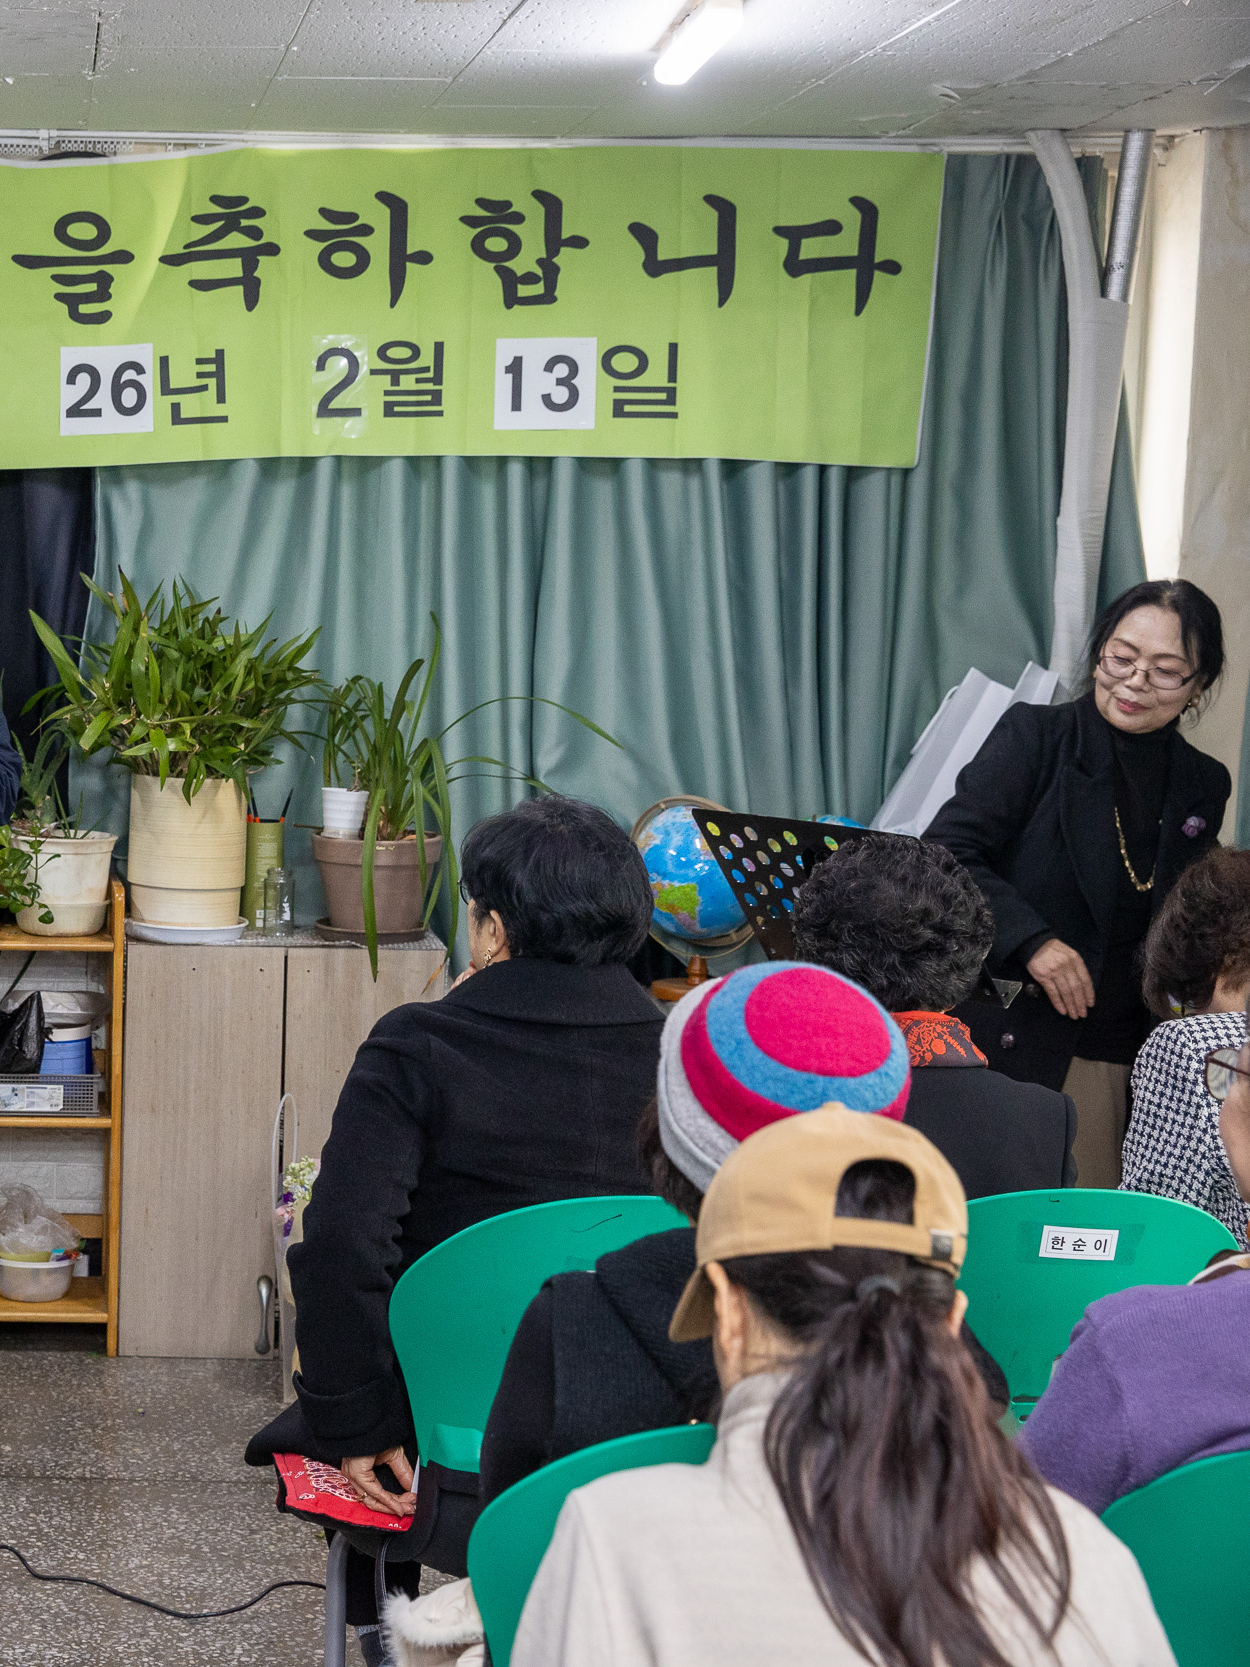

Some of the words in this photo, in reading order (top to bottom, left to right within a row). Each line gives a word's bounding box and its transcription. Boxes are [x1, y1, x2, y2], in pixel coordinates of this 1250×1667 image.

[65, 349, 229, 427] 26년
[314, 341, 445, 419] 2월
[503, 342, 679, 420] 13일
[1051, 1236, 1108, 1253] 한순이
